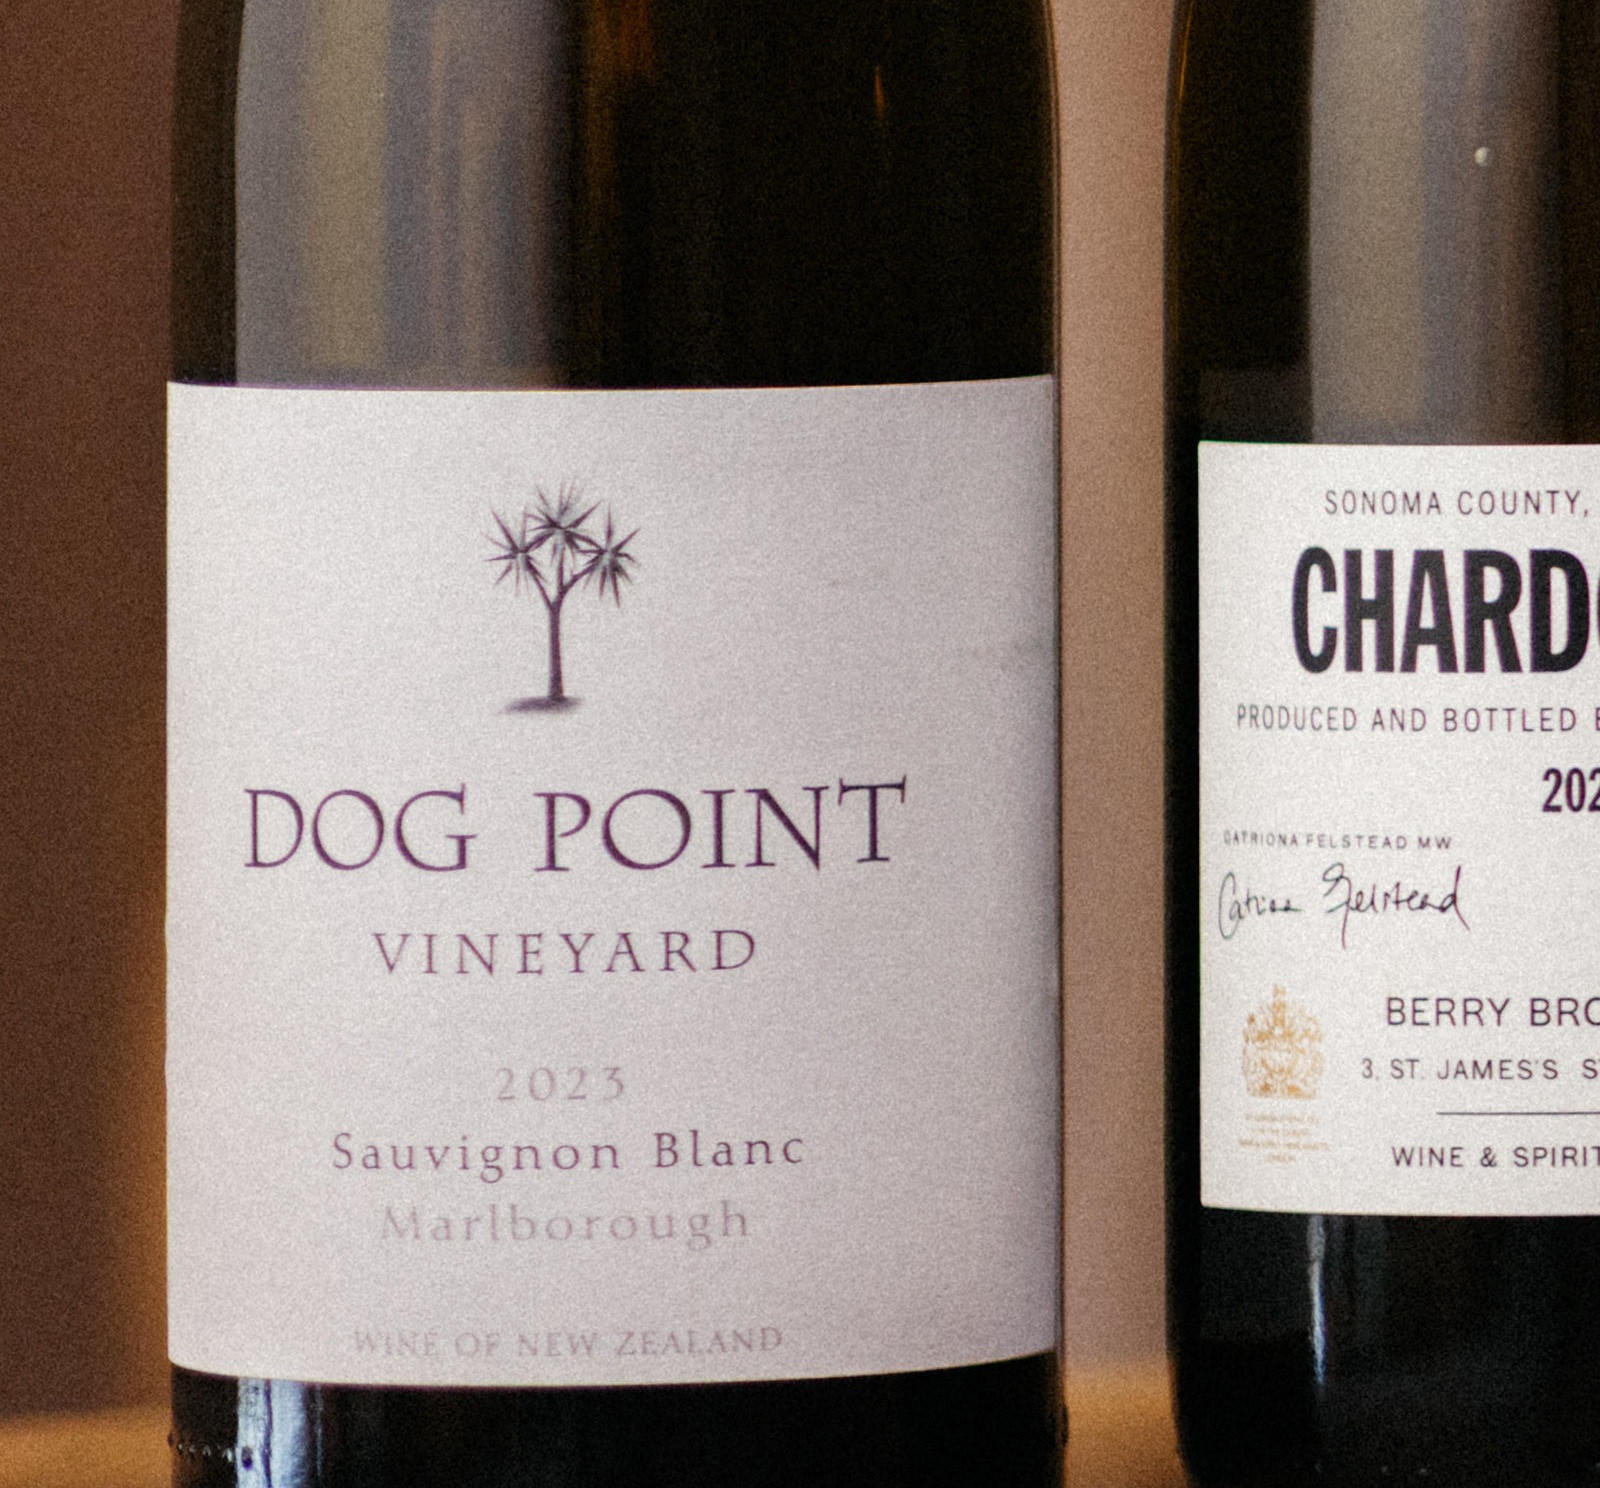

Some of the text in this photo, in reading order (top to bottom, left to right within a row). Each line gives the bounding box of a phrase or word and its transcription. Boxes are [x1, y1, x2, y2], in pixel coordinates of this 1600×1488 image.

[1326, 490, 1441, 515] SONOMA
[1457, 489, 1588, 517] COUNTY,
[1237, 703, 1357, 732] PRODUCED
[1372, 708, 1426, 732] AND
[1444, 707, 1577, 733] BOTTLED
[247, 776, 906, 872] DOG POINT
[1225, 831, 1450, 849] CATRIONA FELSTEAD MW
[373, 929, 755, 975] VINEYARD
[1387, 997, 1510, 1026] BERRY
[497, 1066, 625, 1102] 2023
[1438, 1059, 1558, 1080] JAMES'S
[333, 1129, 802, 1184] Sauvignon Blanc
[1392, 1147, 1462, 1167] WINE
[1480, 1147, 1497, 1168] &
[382, 1200, 748, 1252] Marlborough
[354, 1327, 783, 1357] WINE OF NEW ZEALAND
